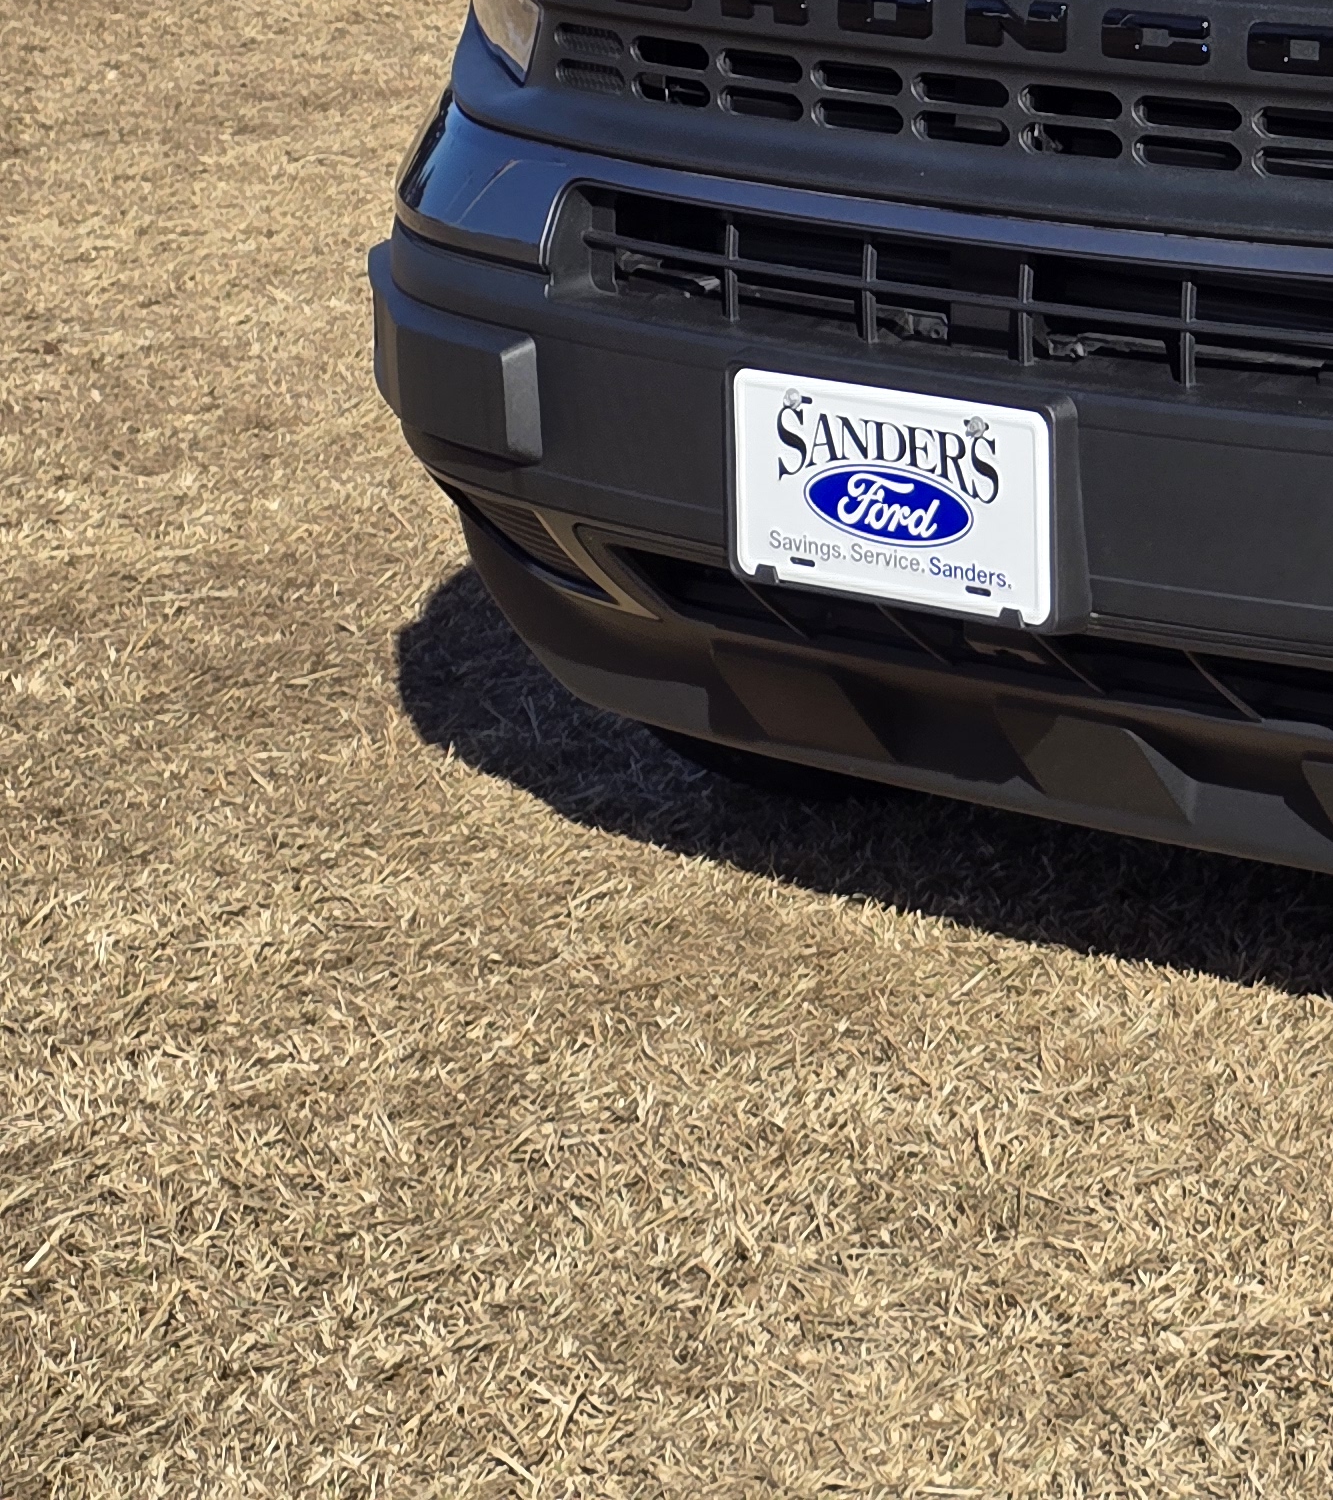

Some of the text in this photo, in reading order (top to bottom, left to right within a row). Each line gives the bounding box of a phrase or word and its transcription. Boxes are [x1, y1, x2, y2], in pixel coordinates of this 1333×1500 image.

[776, 404, 1000, 504] SANDERS
[837, 472, 941, 539] Ford
[769, 530, 1009, 589] Savings. Service. Sanders.
